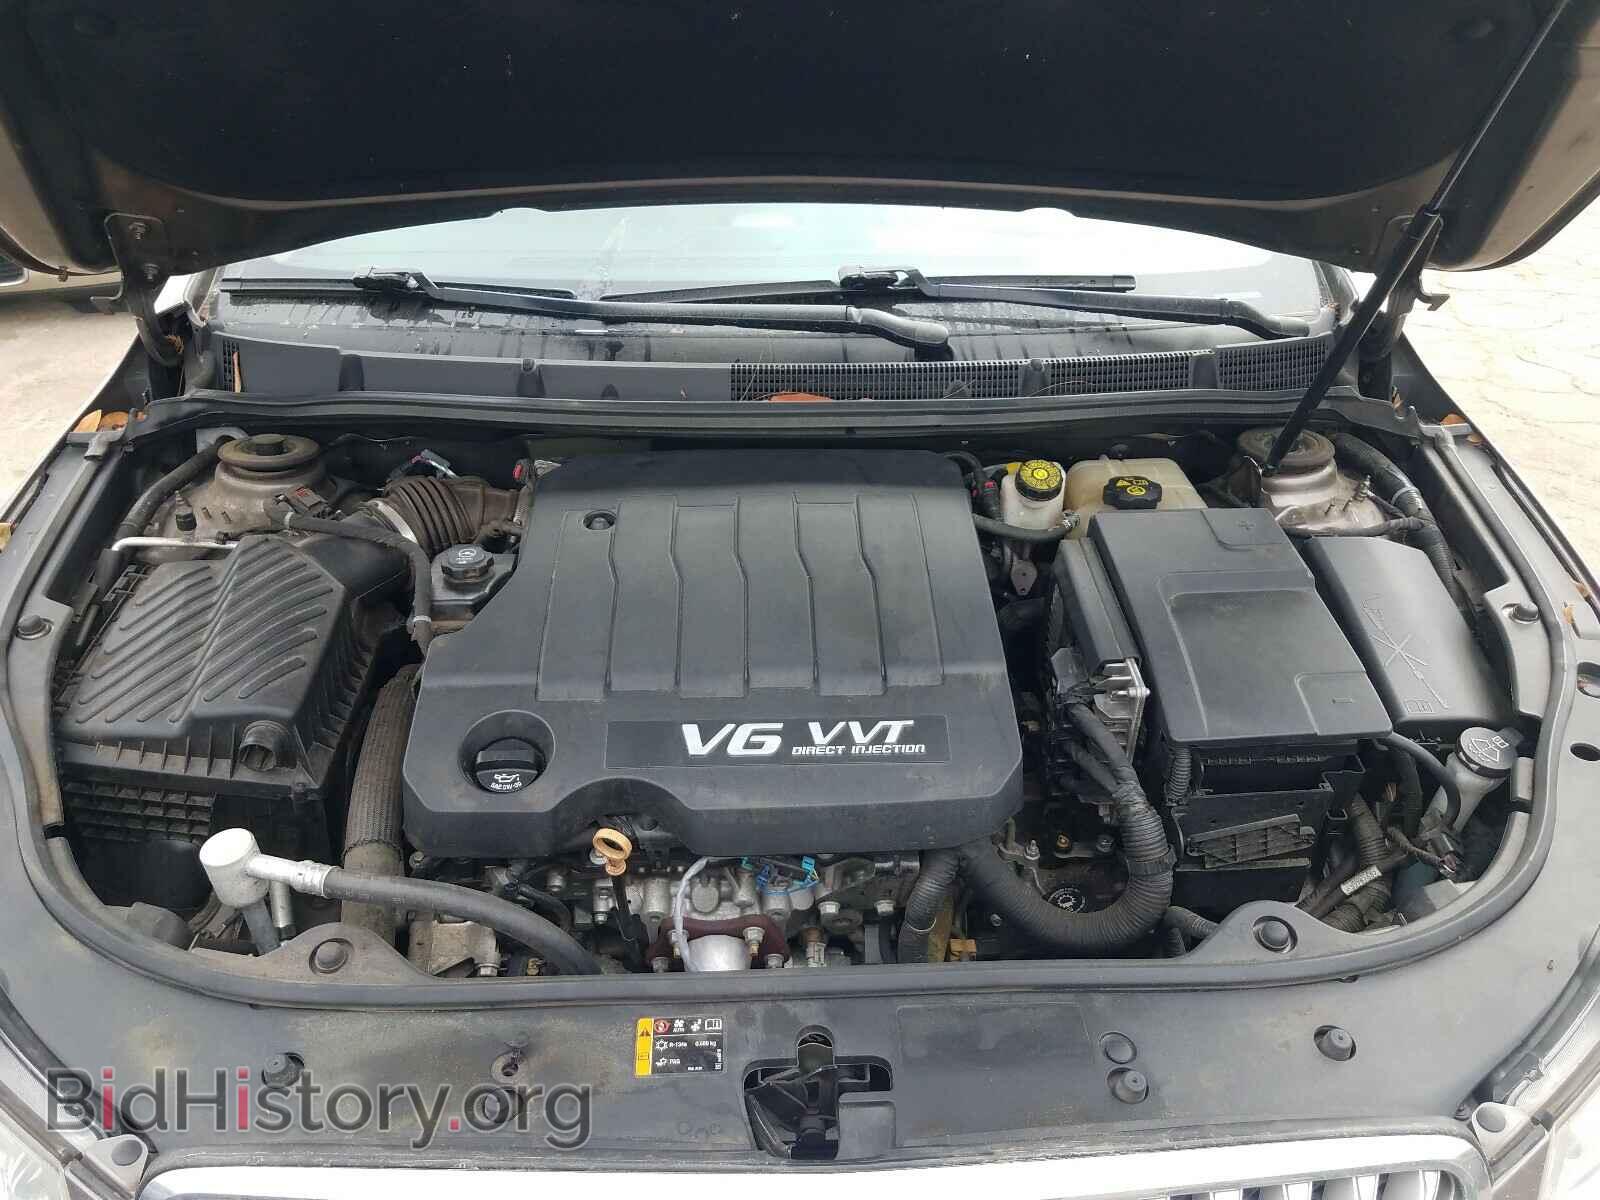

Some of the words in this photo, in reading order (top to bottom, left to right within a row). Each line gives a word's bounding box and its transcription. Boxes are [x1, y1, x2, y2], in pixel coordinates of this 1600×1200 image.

[681, 722, 784, 757] V6
[807, 719, 914, 745] VVT
[791, 745, 846, 755] DIRECT
[851, 744, 926, 754] INJECTION
